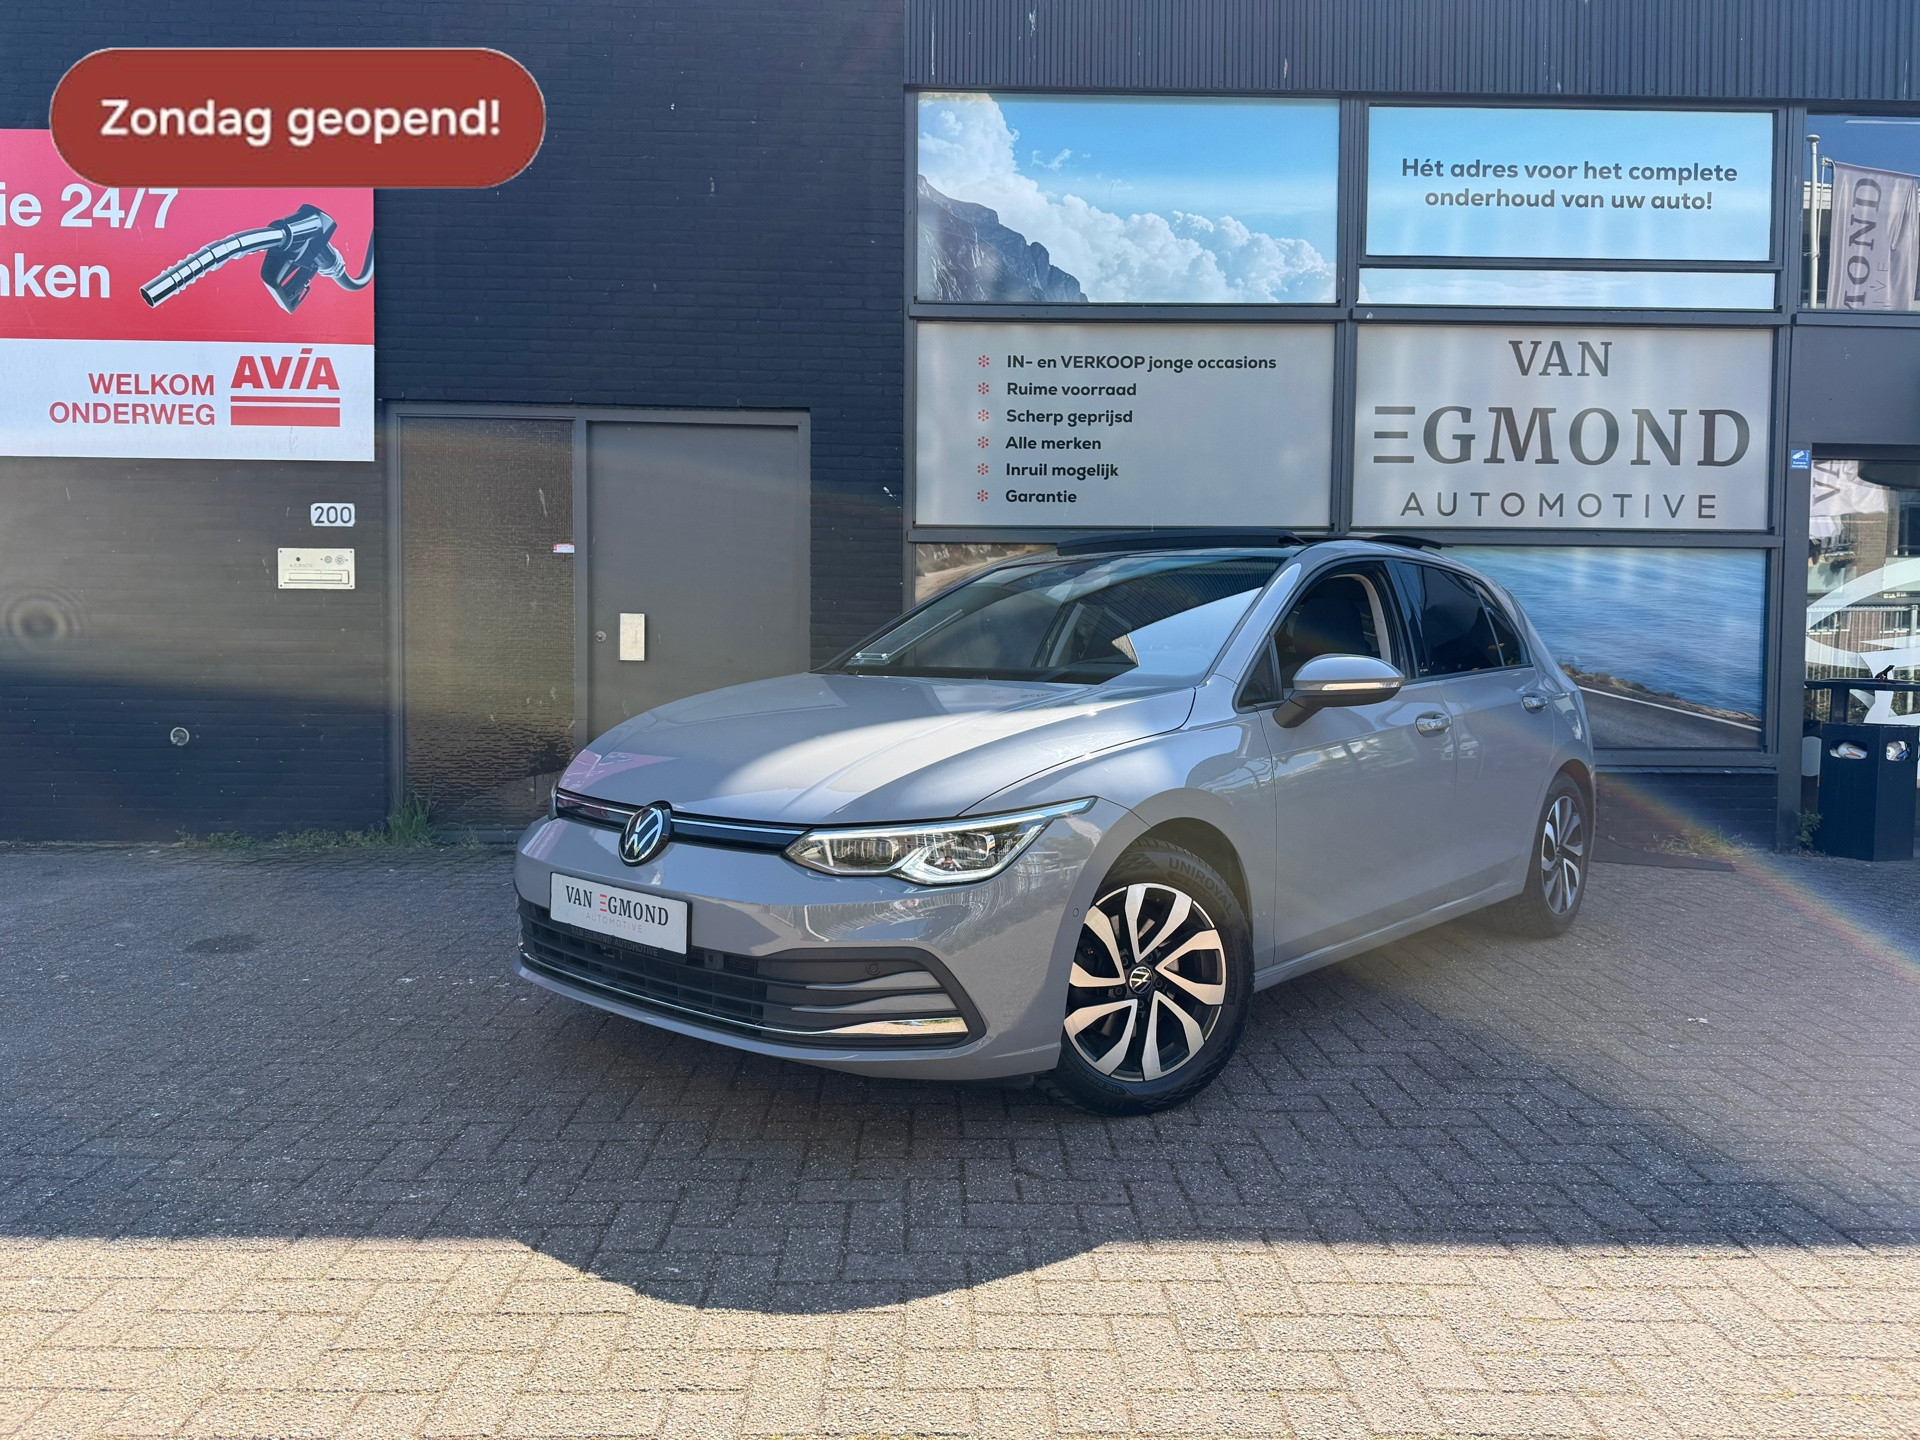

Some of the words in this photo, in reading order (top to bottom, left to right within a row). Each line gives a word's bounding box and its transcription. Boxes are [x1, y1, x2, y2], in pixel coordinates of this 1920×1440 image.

[1402, 157, 1444, 178] Hét
[1450, 160, 1518, 180] adres
[1523, 166, 1578, 180] voor
[1583, 161, 1623, 181] het
[1628, 163, 1738, 185] complete
[60, 183, 179, 229] 24/7
[1425, 188, 1555, 209] onderhoud
[1560, 193, 1604, 209] van
[1610, 194, 1645, 210] uw
[1650, 191, 1713, 211] auto!
[1007, 355, 1033, 369] IN-
[1037, 359, 1057, 370] en
[1061, 355, 1145, 369] VERKOOP
[1147, 356, 1193, 373] jonge
[1198, 356, 1277, 370] occasions
[1508, 340, 1612, 376] VAN
[88, 373, 215, 397] WELKOM
[1007, 383, 1057, 396] Ruime
[1061, 383, 1137, 396] voorraad
[49, 402, 216, 427] ONDERWEG
[1006, 409, 1064, 426] Scherp
[1067, 410, 1133, 426] geprijsd
[1005, 437, 1038, 450] Alle
[1041, 437, 1101, 450] merken
[1373, 405, 1751, 467] EGMOND
[1006, 463, 1048, 477] Inruil
[1051, 463, 1119, 480] mogelijk
[1005, 490, 1077, 504] Garantie
[1400, 491, 1717, 519] AUTOMOTIVE
[313, 505, 353, 525] 200
[566, 885, 593, 908] VAN
[600, 893, 669, 926] EGMOND
[586, 911, 643, 933] AUTOMOTIVE
